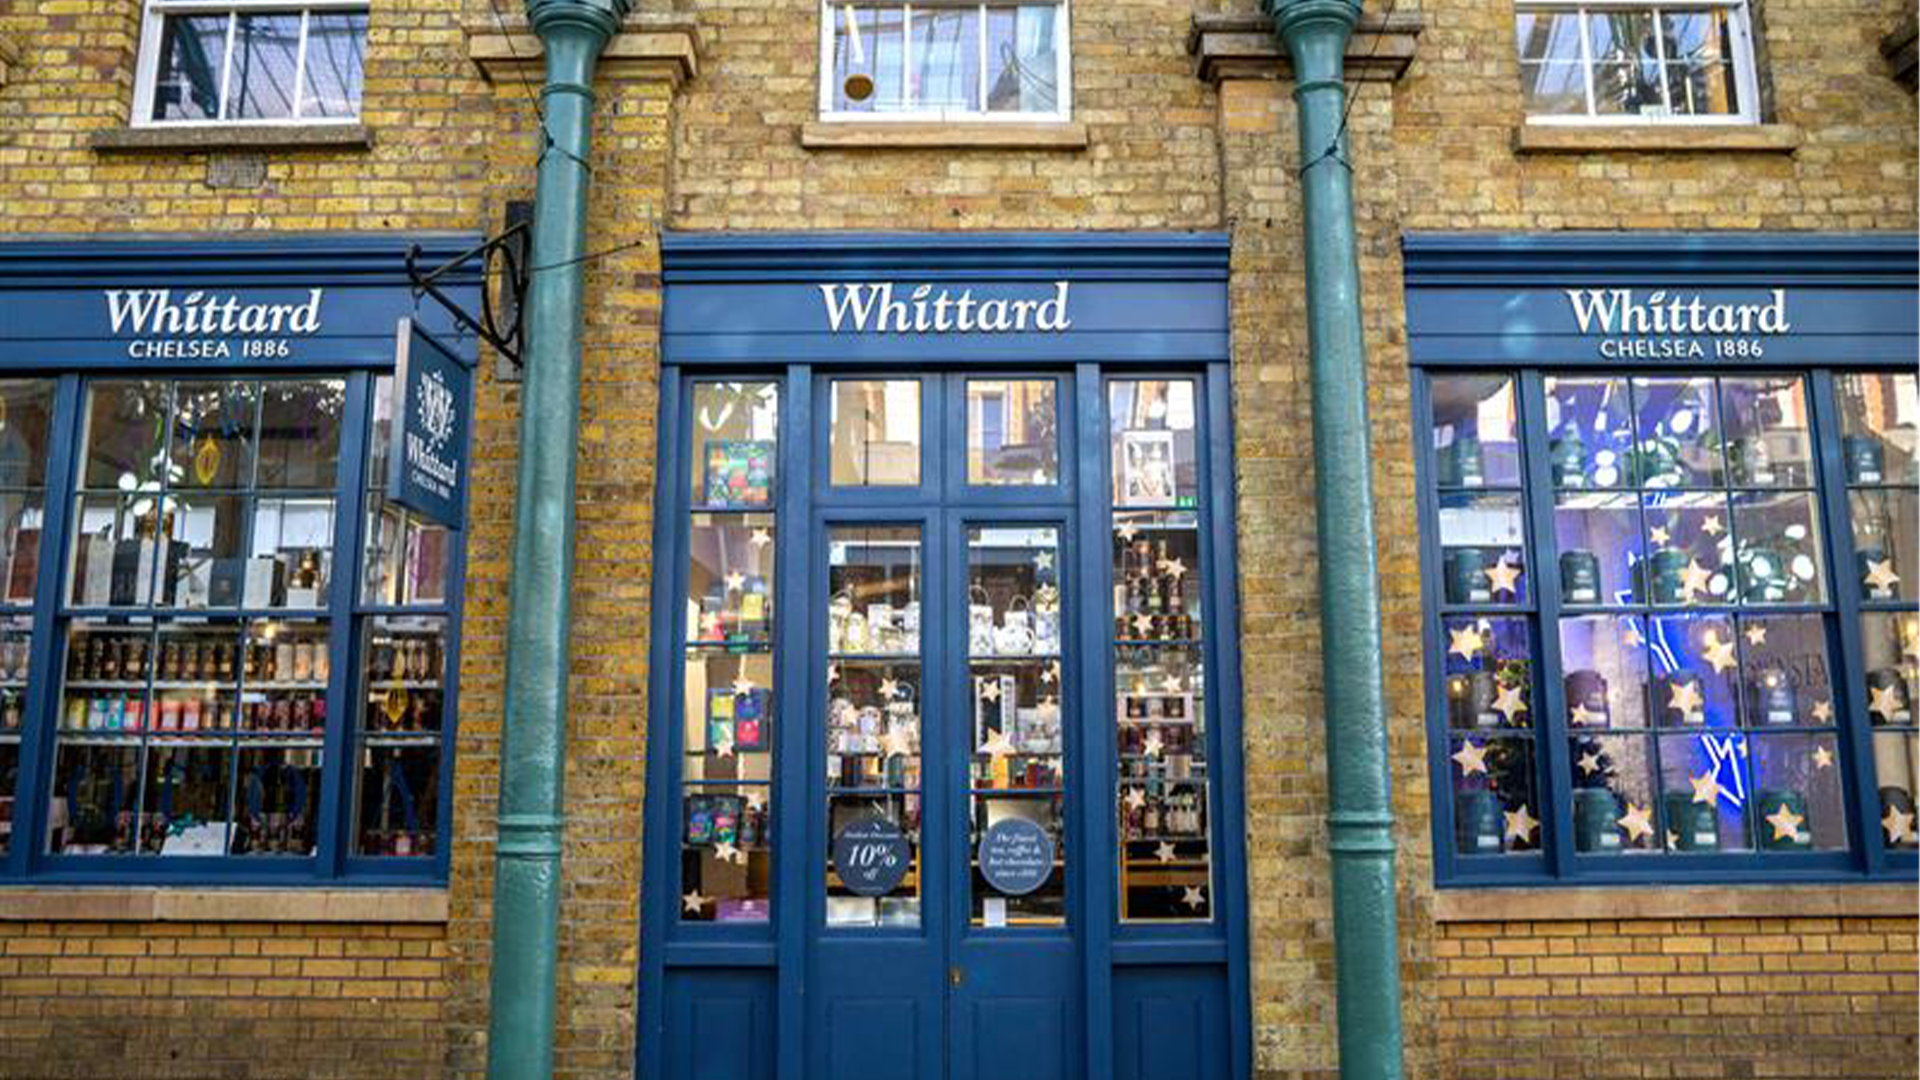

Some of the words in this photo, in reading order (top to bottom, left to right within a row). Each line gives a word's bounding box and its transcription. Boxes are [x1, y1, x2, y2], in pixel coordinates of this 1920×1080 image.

[105, 288, 323, 334] Whittard
[818, 280, 1072, 332] Whittard
[1566, 288, 1791, 333] Whittard
[128, 339, 231, 358] CHELSEA
[242, 339, 290, 358] 1886
[1600, 339, 1705, 358] CHELSEA
[1715, 338, 1764, 358] 1886
[406, 431, 458, 487] Whittard
[848, 843, 898, 868] 10%
